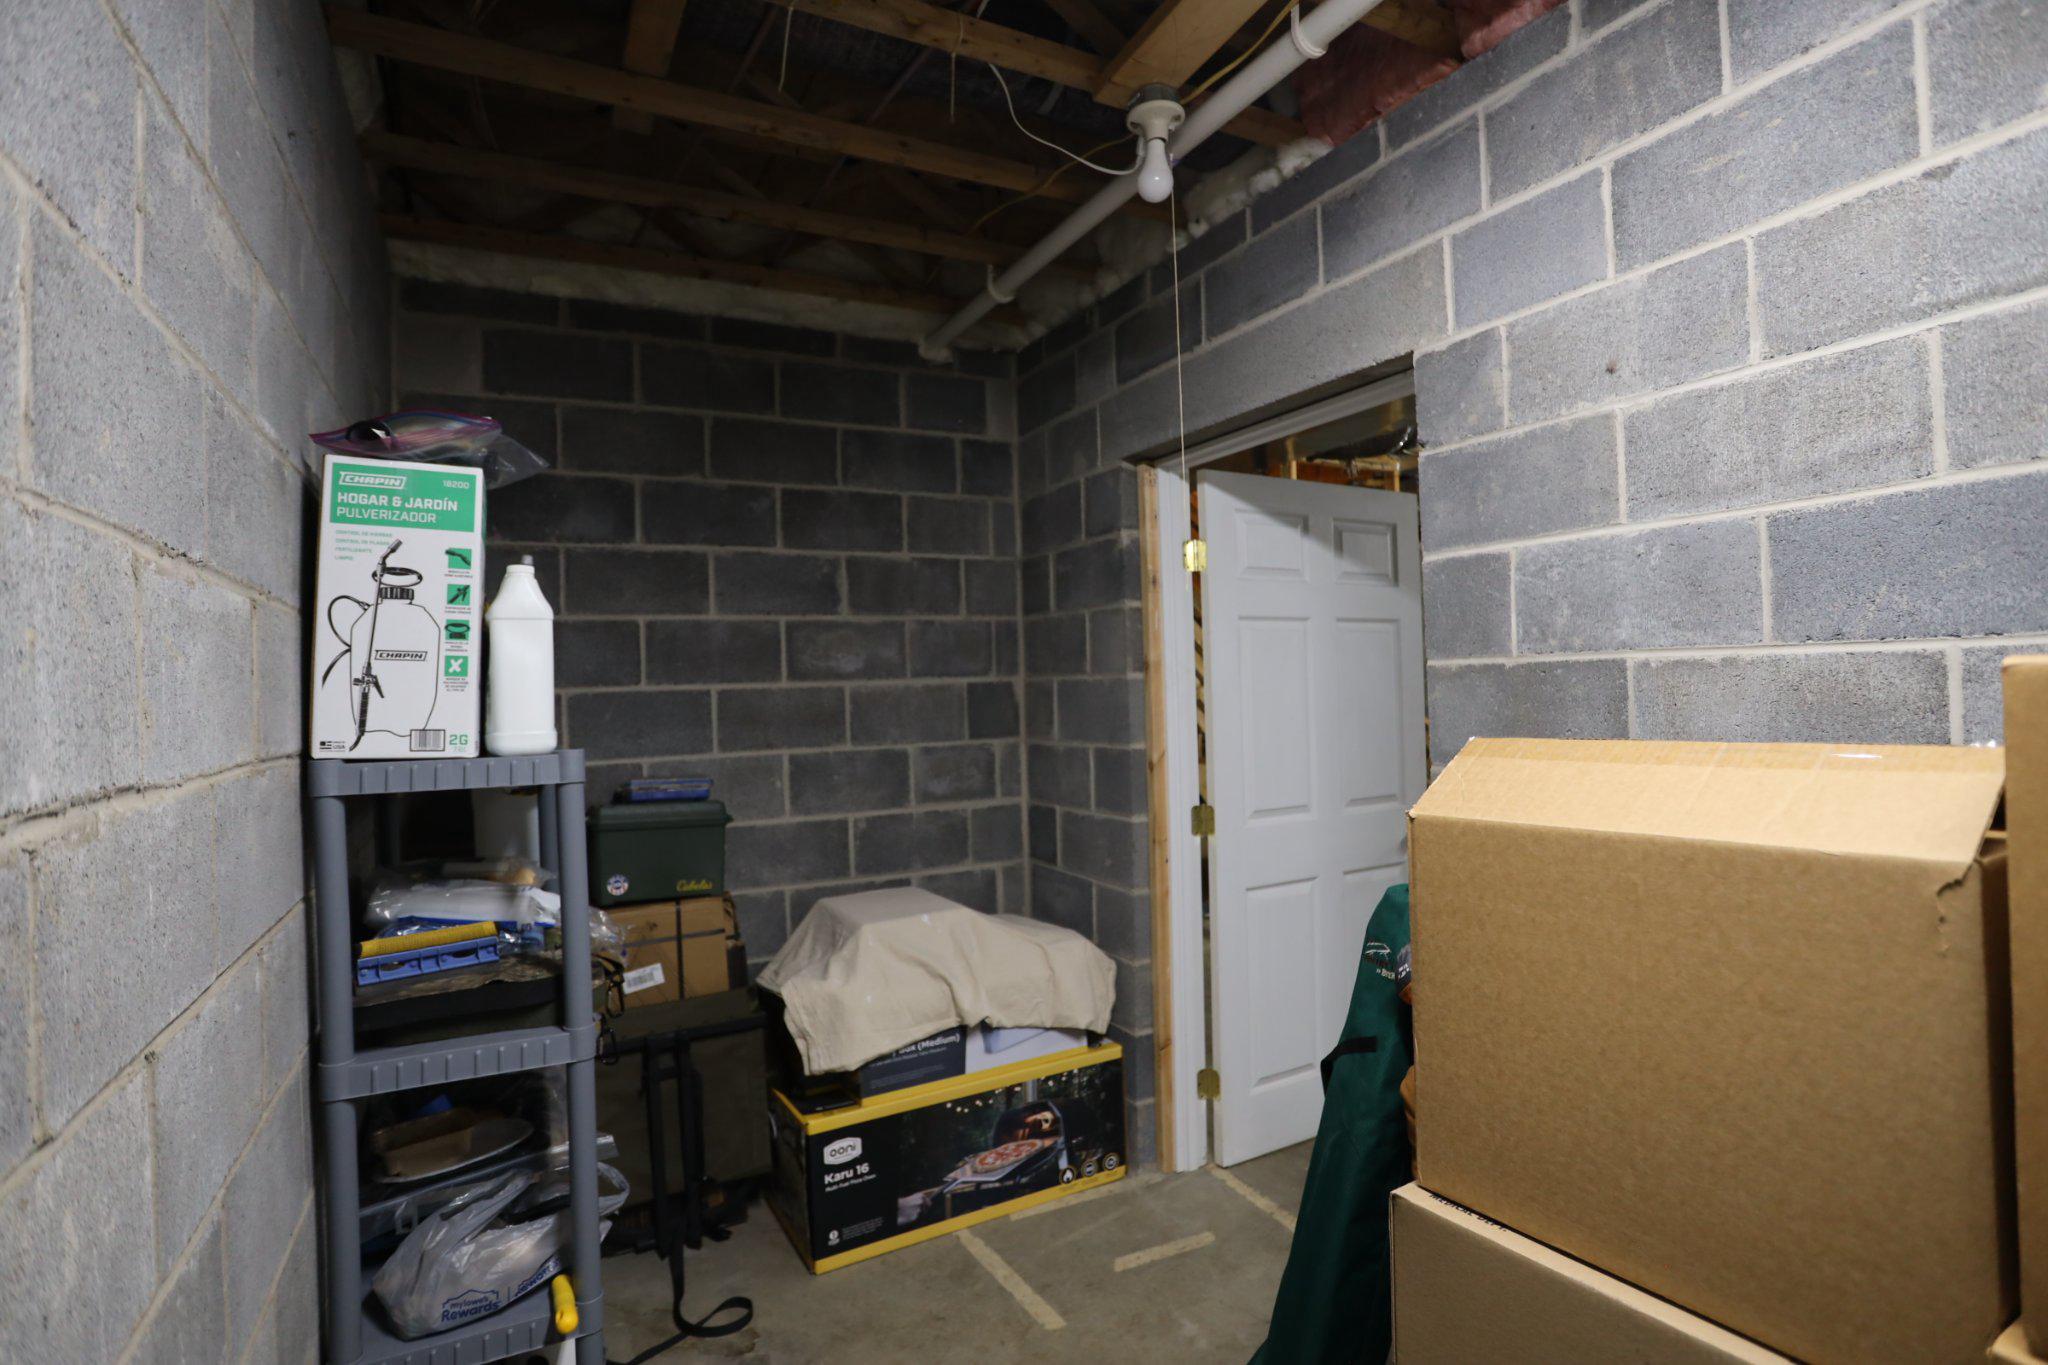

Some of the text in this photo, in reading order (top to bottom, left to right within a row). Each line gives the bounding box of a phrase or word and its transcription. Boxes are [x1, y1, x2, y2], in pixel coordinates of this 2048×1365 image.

[343, 474, 403, 487] CHAPIN
[337, 492, 459, 511] HOGAR & JARDÍN
[336, 507, 437, 523] PULVERIZADOR
[377, 651, 425, 660] CHAPIN
[449, 734, 468, 745] 2G
[917, 1032, 960, 1051] (Medium)
[829, 1142, 857, 1158] ooni
[824, 1162, 870, 1185] Karu 16
[441, 1300, 502, 1322] Rewards
